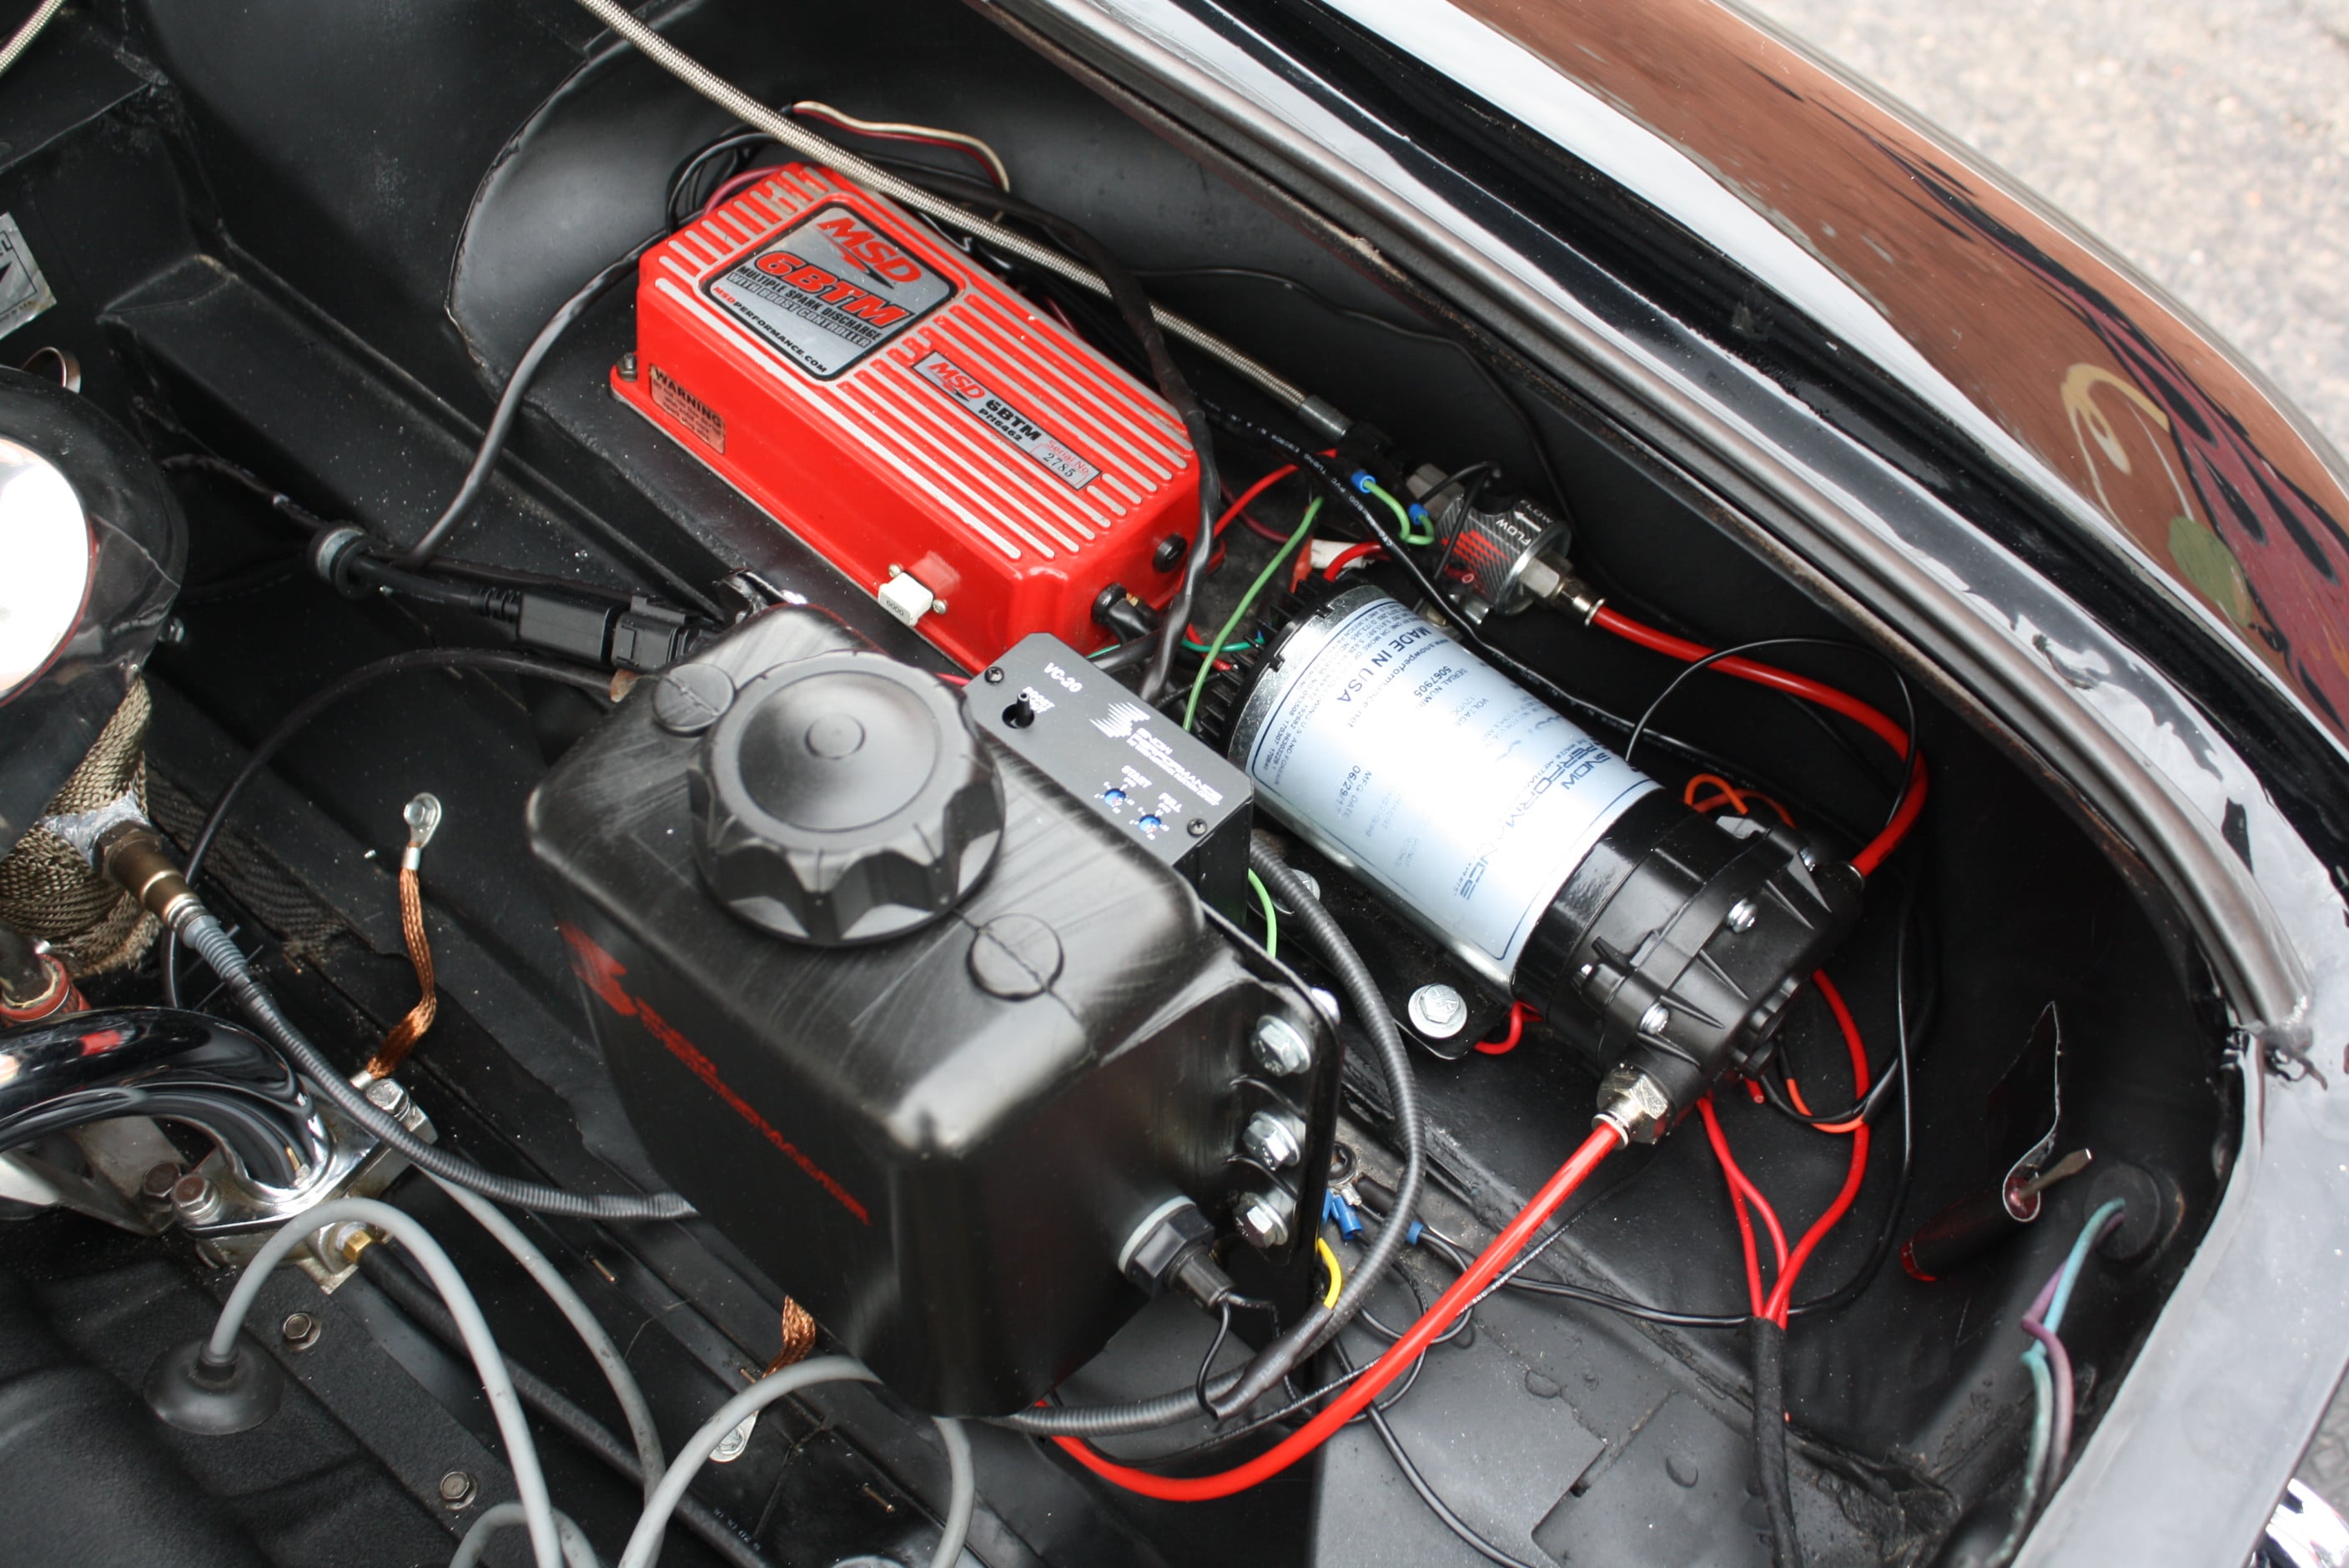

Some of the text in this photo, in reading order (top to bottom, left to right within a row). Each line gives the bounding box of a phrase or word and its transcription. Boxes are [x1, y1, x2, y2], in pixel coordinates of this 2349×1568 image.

[816, 217, 922, 282] MSD
[737, 265, 883, 340] MULTIPLE SPARK DISCHARGE
[754, 251, 915, 328] 6BTM
[727, 273, 871, 348] WITH BOOST CONTROLLER
[713, 287, 827, 373] MSDPERFORMANCE.COM
[654, 368, 722, 427] WARNING
[928, 362, 985, 398] MSD
[985, 399, 1041, 440] 6BTM
[1043, 452, 1075, 477] 2785
[1047, 440, 1075, 461] Serial
[1496, 519, 1532, 545] FLOW
[1386, 626, 1432, 653] MADE
[1369, 649, 1394, 669] IN
[1439, 666, 1468, 686] SERIAL
[1044, 662, 1082, 692] VC-20
[1335, 666, 1375, 704] USA
[1411, 665, 1452, 699] 5067905
[1121, 764, 1152, 788] START
[1558, 751, 1612, 791] SNOW
[1158, 792, 1183, 813] FULL
